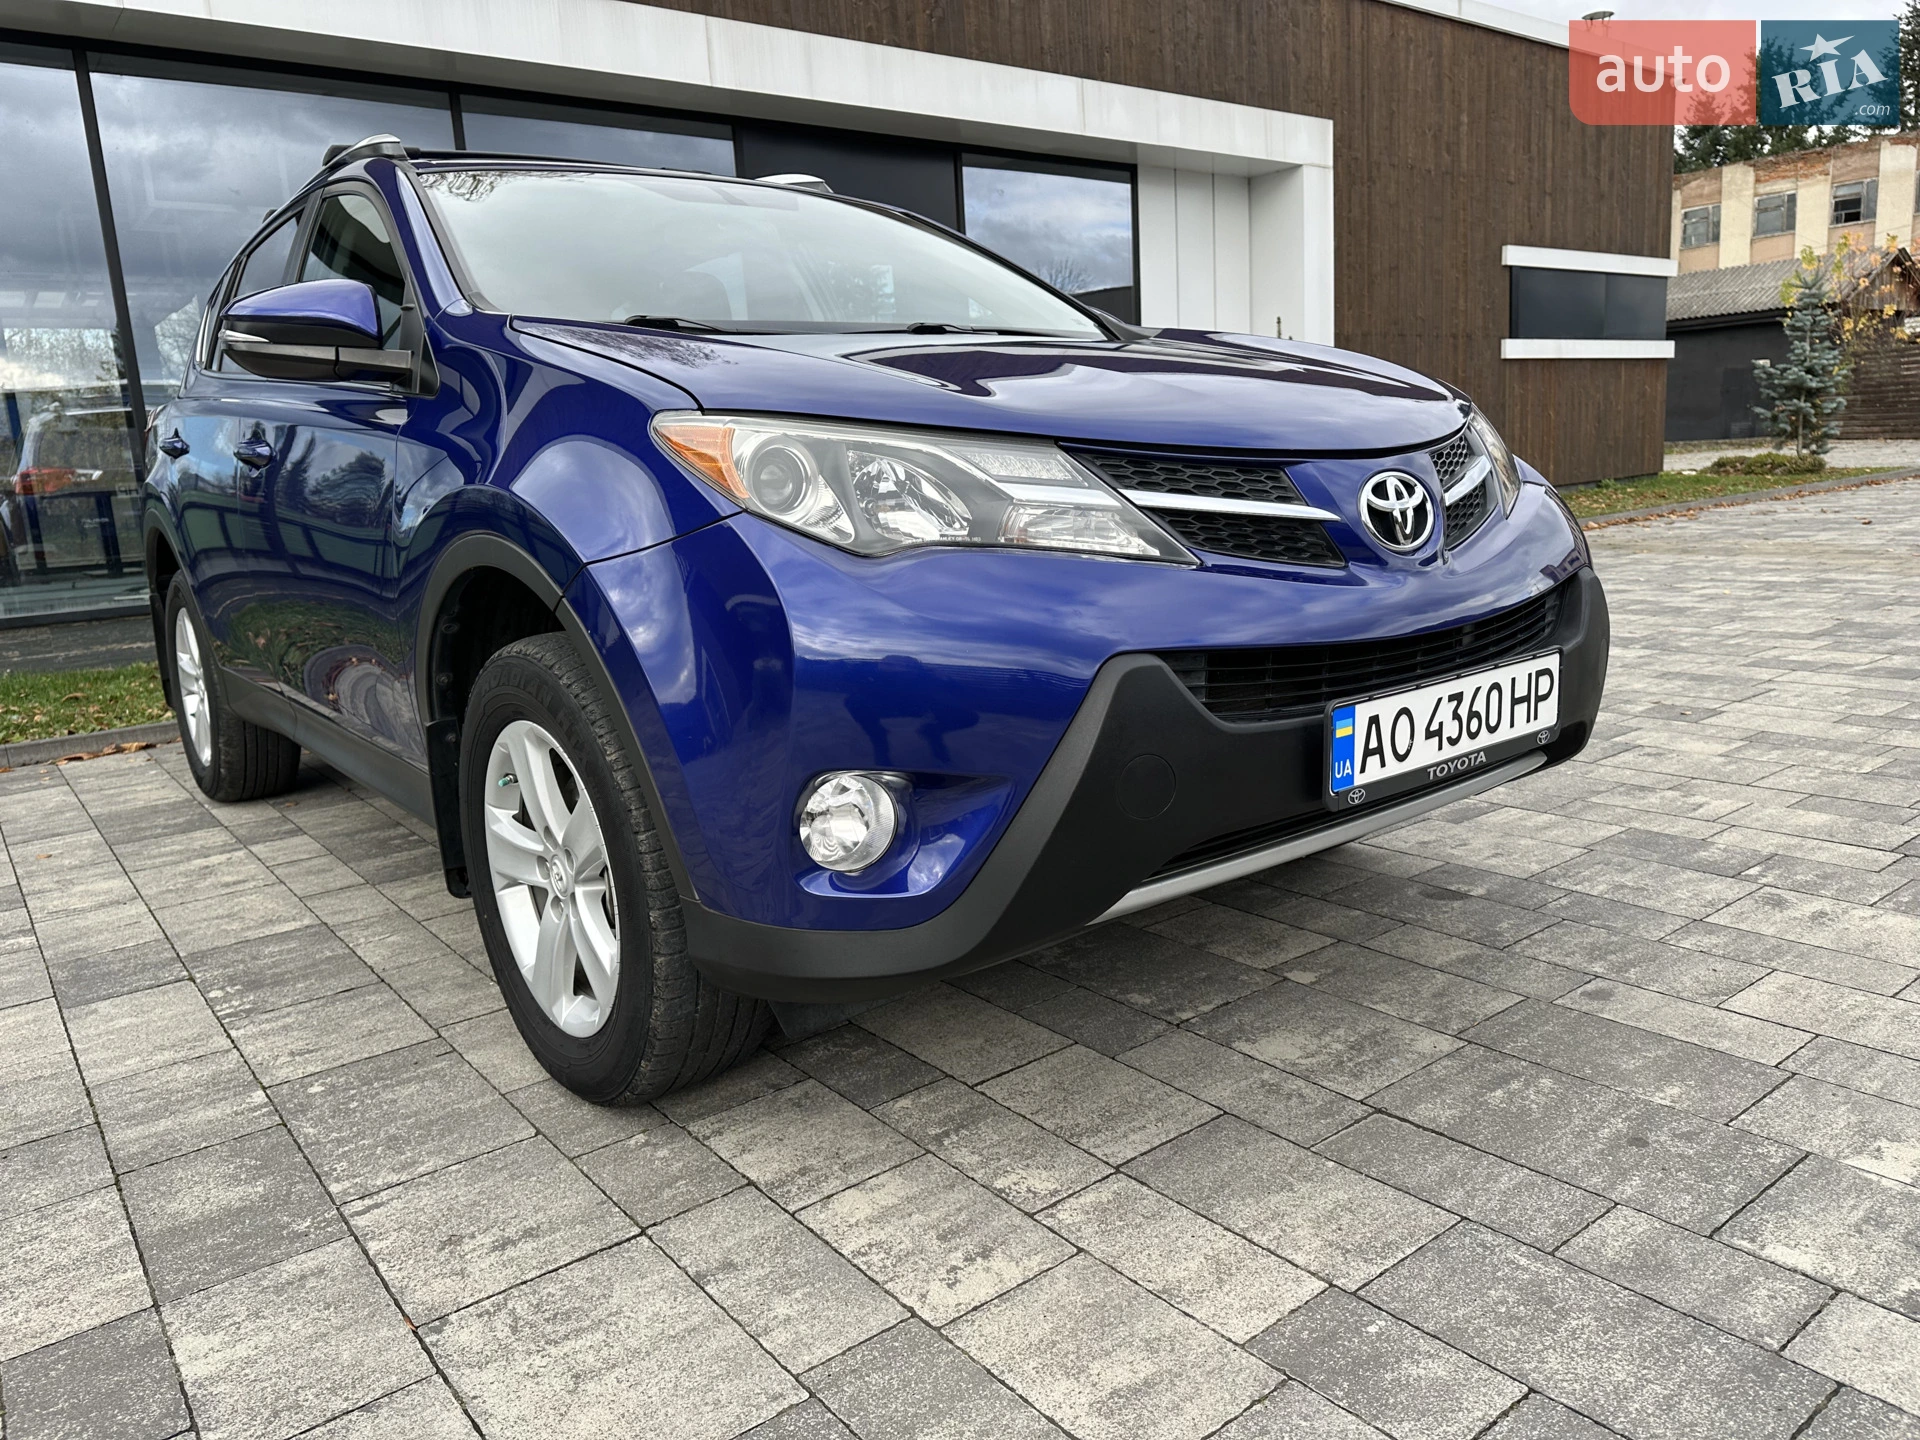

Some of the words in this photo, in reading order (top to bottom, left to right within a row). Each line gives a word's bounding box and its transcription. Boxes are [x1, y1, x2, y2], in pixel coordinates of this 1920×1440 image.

[1359, 706, 1415, 774] AO
[1424, 682, 1503, 751] 4360
[1509, 667, 1554, 729] HP
[1335, 761, 1352, 779] UA
[1427, 750, 1487, 781] TOYOTA
